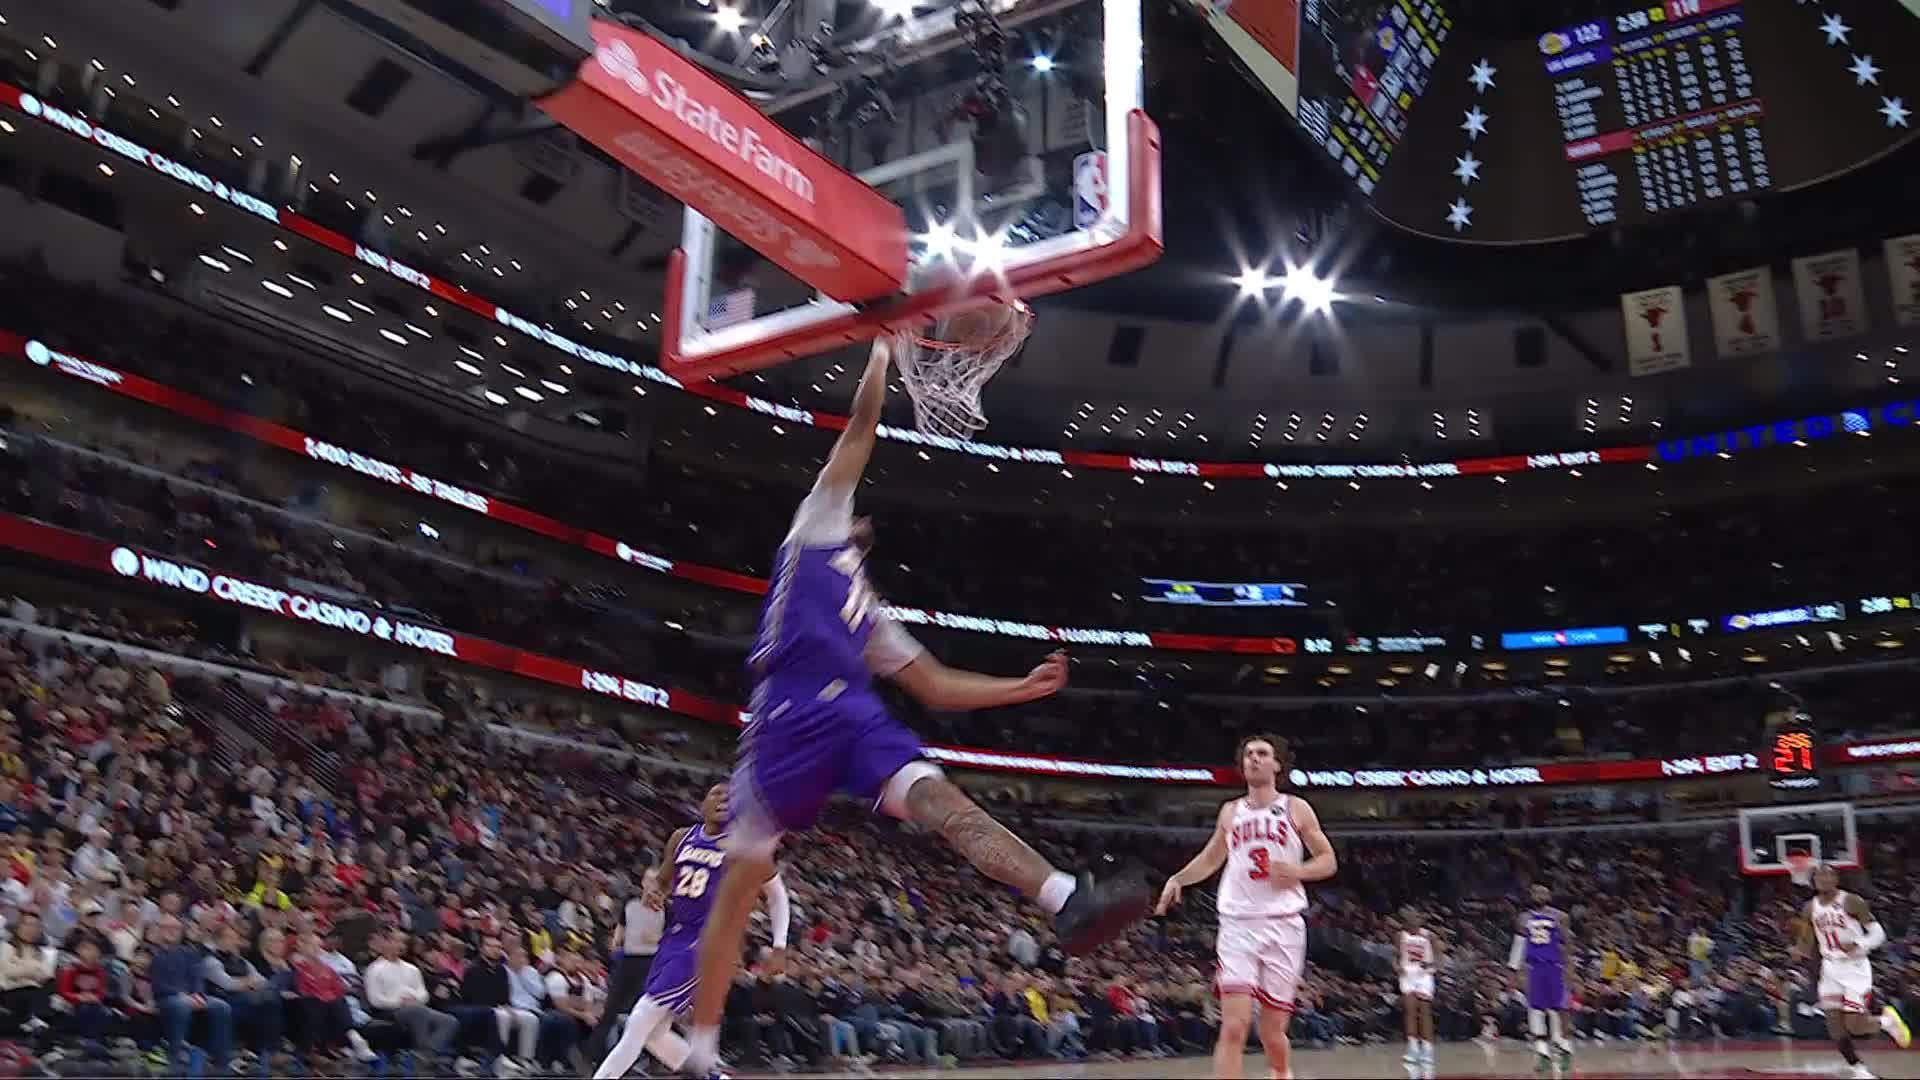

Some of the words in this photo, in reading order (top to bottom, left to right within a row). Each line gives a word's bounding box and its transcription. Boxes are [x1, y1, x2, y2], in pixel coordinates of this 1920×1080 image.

[1656, 416, 1833, 462] UNITED
[143, 555, 210, 593] WIND
[211, 574, 290, 614] CREEK
[287, 595, 372, 635] CASINO
[395, 621, 459, 657] HOTEL
[1307, 769, 1354, 786] WIND
[1353, 770, 1409, 786] CREEK
[1407, 770, 1472, 786] CASINO
[1488, 766, 1544, 784] HOTEL
[1232, 816, 1288, 848] BULLS
[1248, 848, 1269, 880] 3
[674, 865, 710, 898] 28
